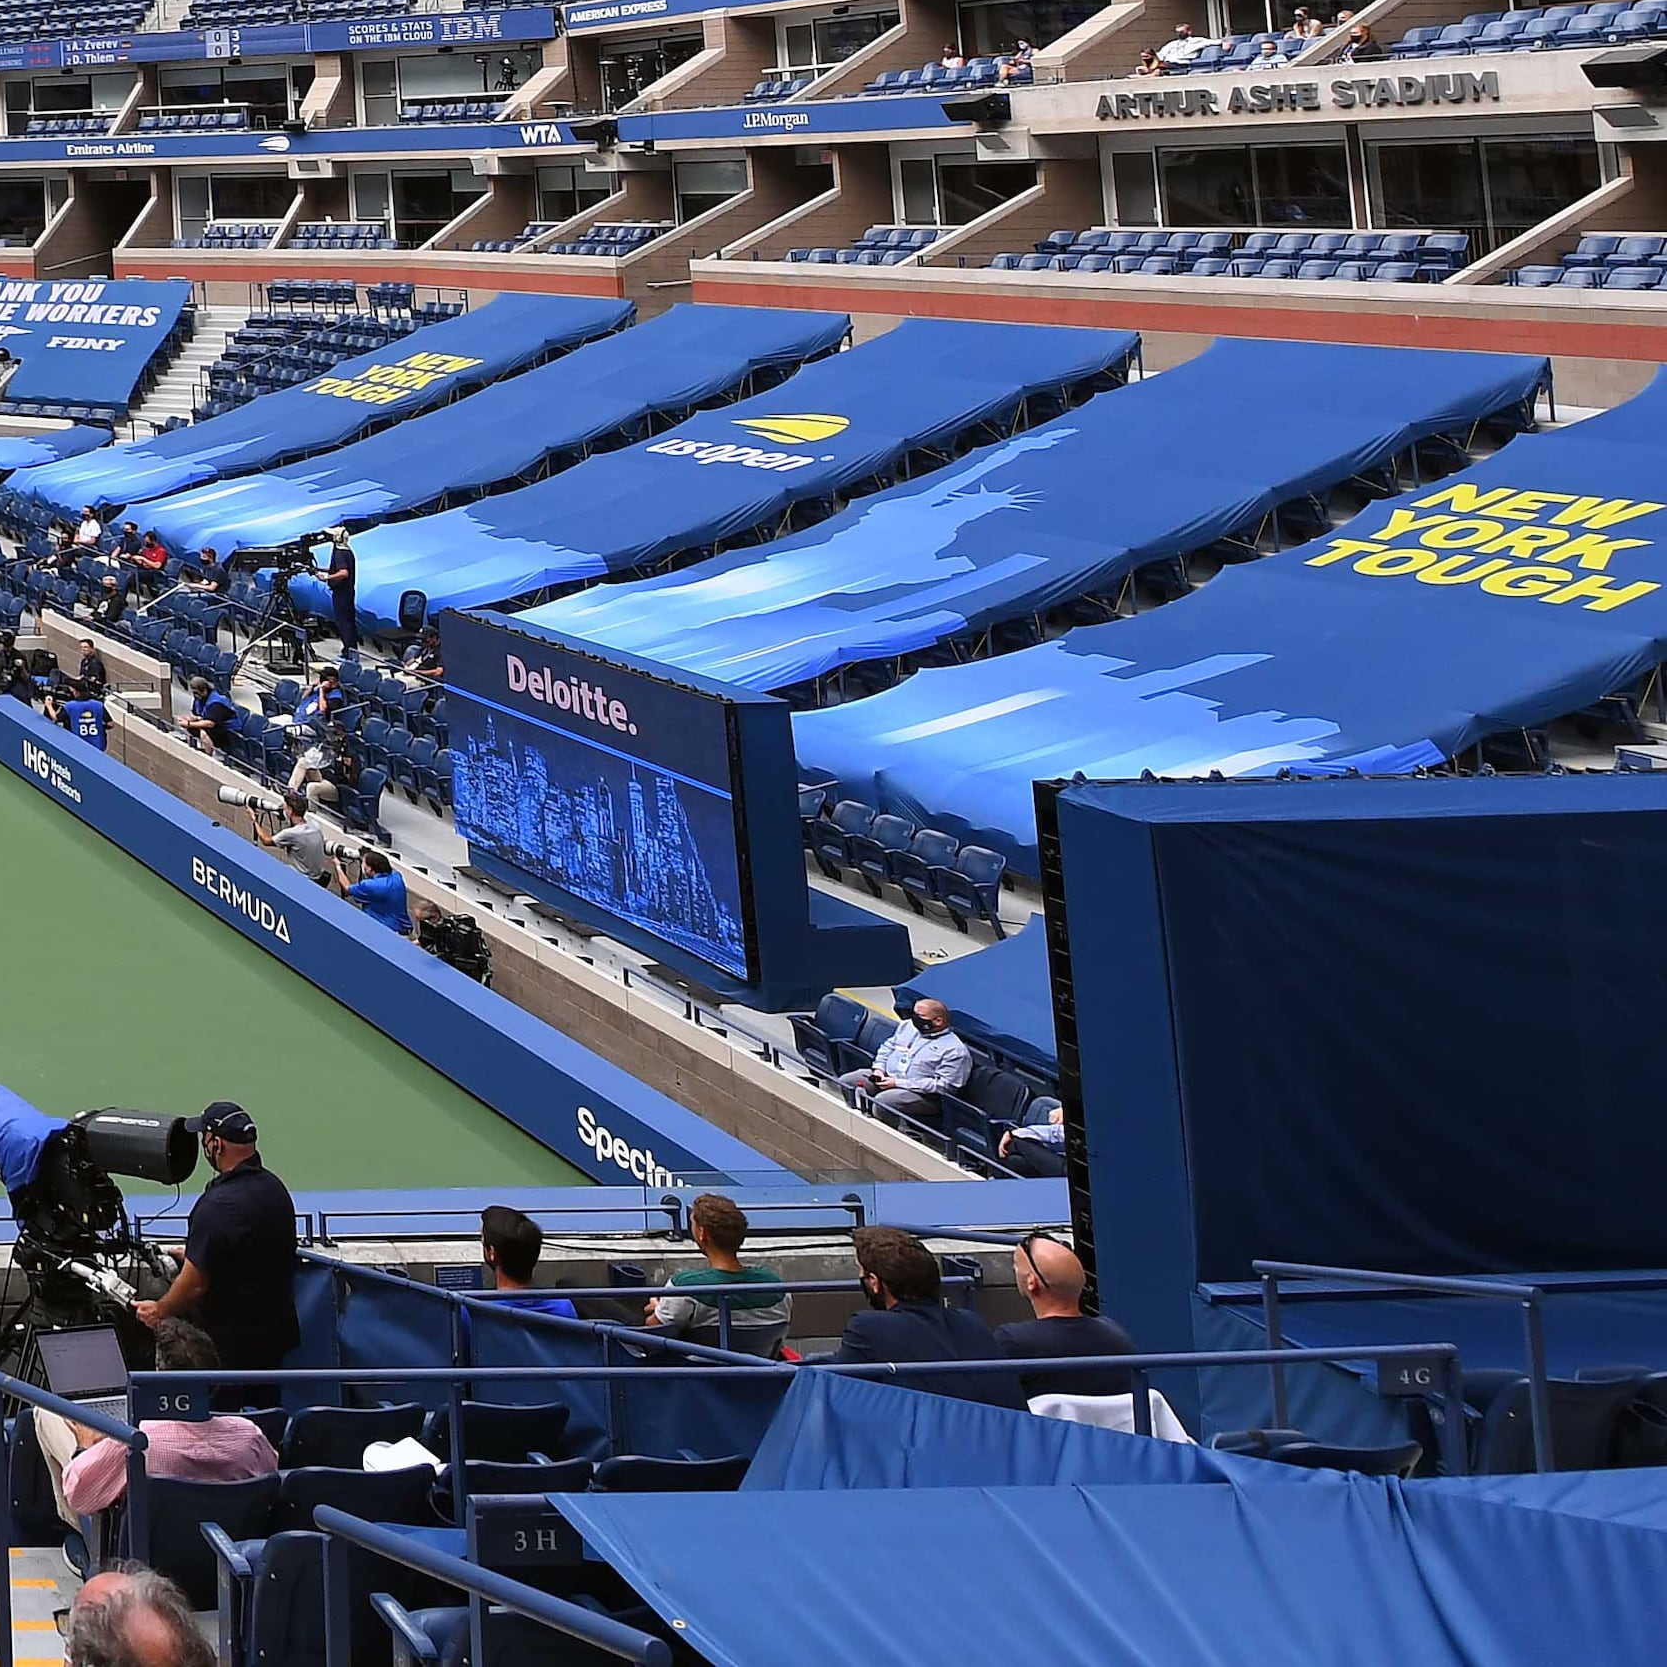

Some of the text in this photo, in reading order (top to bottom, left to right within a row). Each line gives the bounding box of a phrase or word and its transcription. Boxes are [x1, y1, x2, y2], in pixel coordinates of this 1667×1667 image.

[570, 0, 667, 22] AMERICAN EXPRESS
[348, 21, 433, 35] SCORES STATS
[349, 30, 433, 44] ON THE IBM CLOUD
[440, 15, 501, 38] IBM
[71, 39, 117, 50] A. Zverev
[72, 54, 115, 64] D. Thiem
[1096, 71, 1500, 120] ARTHUR ASHE STADIUM
[743, 112, 808, 130] J.P.Morgan
[520, 124, 561, 144] WTA
[67, 142, 155, 156] Emirates Airline
[48, 282, 105, 302] YOU
[25, 303, 162, 326] WORKERS
[46, 336, 125, 351] FDNY
[394, 351, 485, 374] NEW
[361, 365, 446, 391] YORK
[302, 377, 412, 405] TOUGH
[1411, 483, 1667, 531] NEW
[1369, 509, 1655, 572] YORK
[1305, 538, 1663, 612] TOUGH
[506, 653, 639, 737] Deloitte.
[79, 723, 98, 736] 86
[23, 739, 48, 780] IHG
[191, 856, 291, 945] BERMUDA
[1400, 1368, 1430, 1385] 4 G
[159, 1395, 190, 1411] 3 G
[514, 1529, 558, 1552] 3 H
